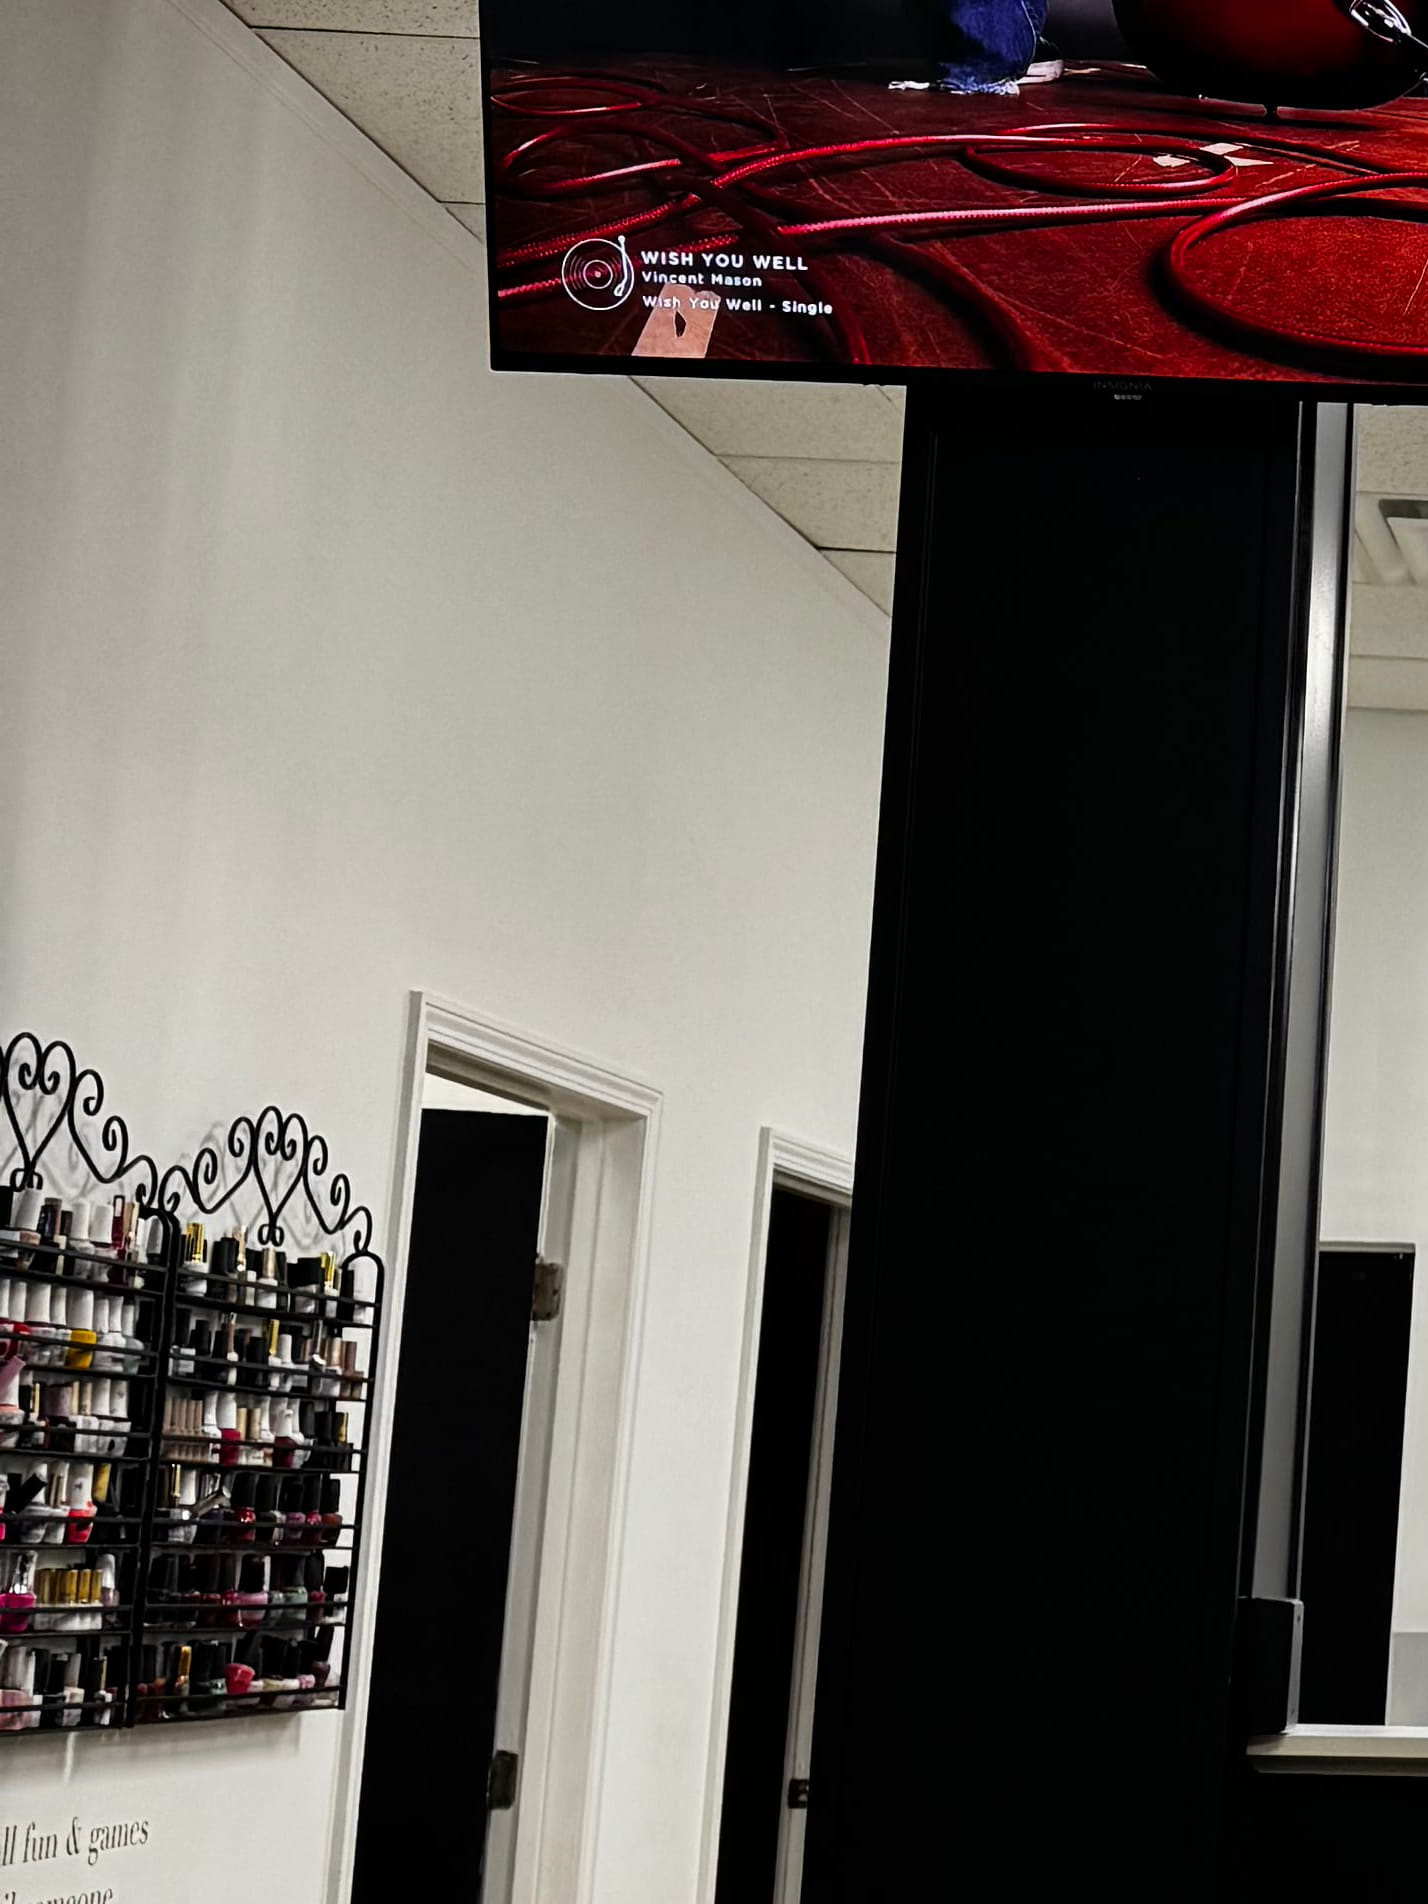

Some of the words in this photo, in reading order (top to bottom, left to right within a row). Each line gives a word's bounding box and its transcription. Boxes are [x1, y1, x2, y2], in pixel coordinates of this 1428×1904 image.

[641, 251, 693, 266] WISH
[702, 253, 743, 268] YOU
[753, 255, 808, 271] WELL
[642, 271, 704, 285] Vincent
[711, 274, 762, 287] Mason
[642, 295, 680, 309] Wish
[689, 297, 720, 310] You
[726, 299, 761, 311] Well
[782, 300, 833, 315] Single
[0, 1825, 17, 1866] ll
[22, 1822, 57, 1863] fun
[66, 1816, 82, 1856] &
[88, 1818, 149, 1866] games
